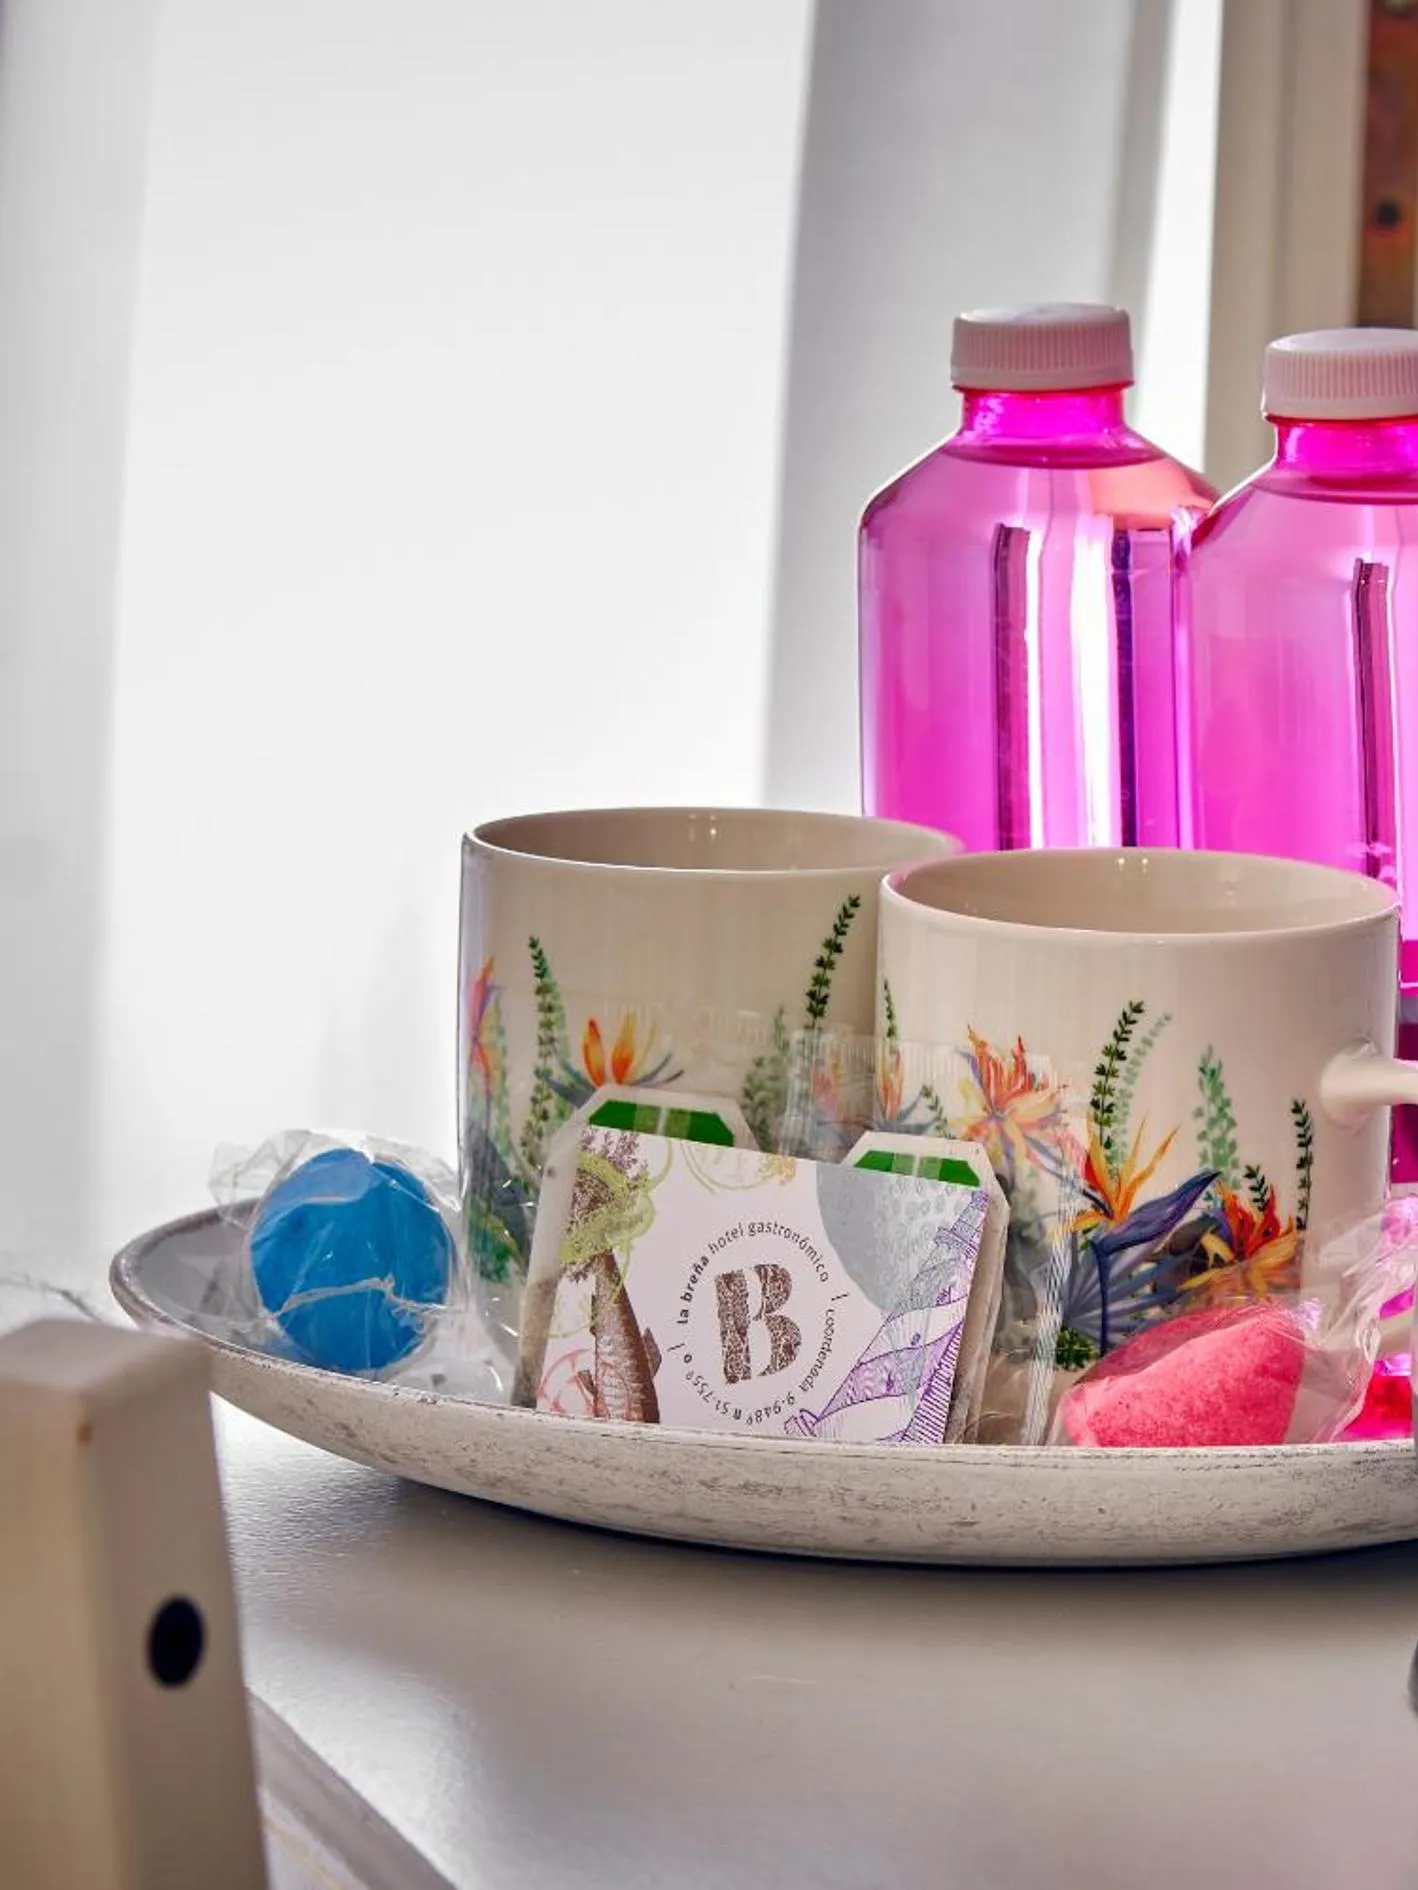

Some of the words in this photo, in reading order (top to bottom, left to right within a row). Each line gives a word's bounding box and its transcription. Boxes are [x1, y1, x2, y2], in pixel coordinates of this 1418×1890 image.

[707, 1222, 744, 1255] hotel
[747, 1221, 829, 1283] gastronómico
[680, 1255, 710, 1303] breña
[677, 1308, 690, 1325] la
[714, 1263, 802, 1385] B
[798, 1308, 835, 1393] coordenada
